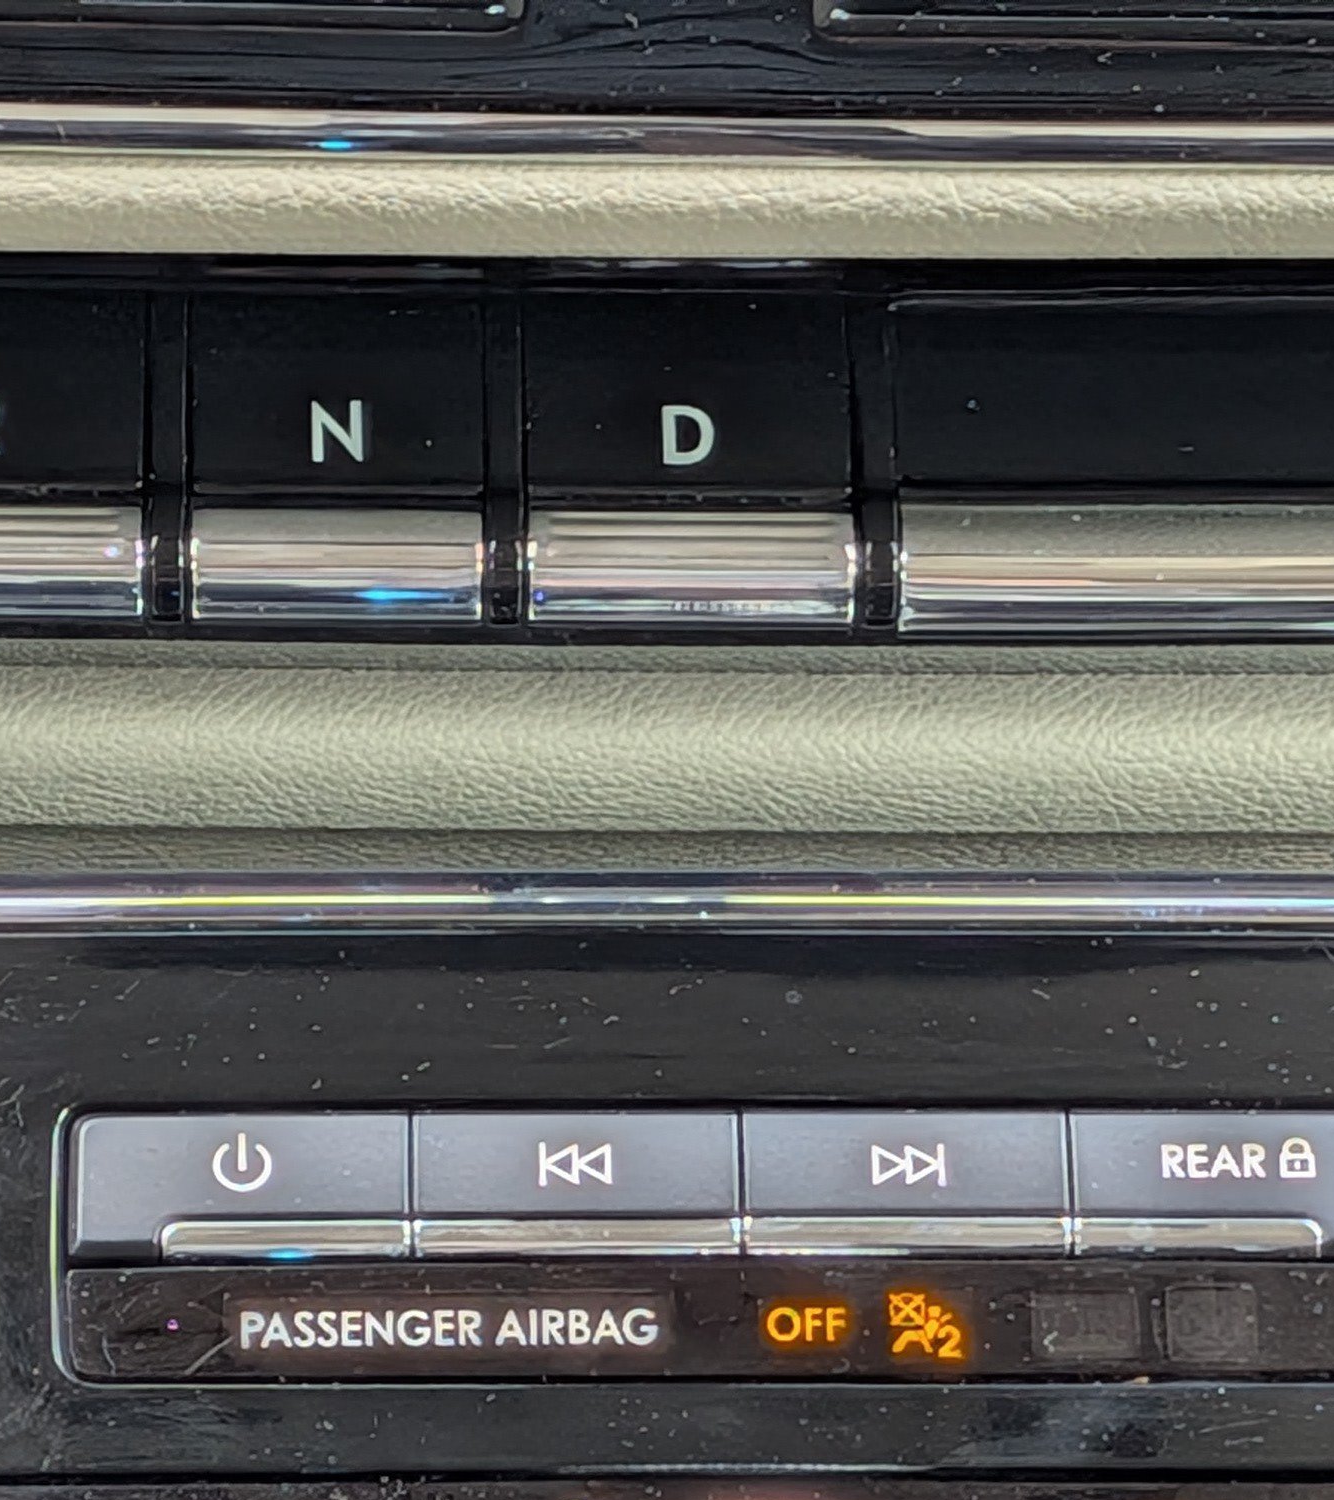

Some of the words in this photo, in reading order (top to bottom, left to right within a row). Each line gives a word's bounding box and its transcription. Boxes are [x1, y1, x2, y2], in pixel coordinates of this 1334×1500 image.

[311, 399, 364, 463] N
[661, 404, 715, 466] D
[1160, 1142, 1267, 1179] REAR
[240, 1309, 482, 1350] PASSENGER
[495, 1308, 659, 1349] AIRBAG
[765, 1306, 848, 1343] OFF
